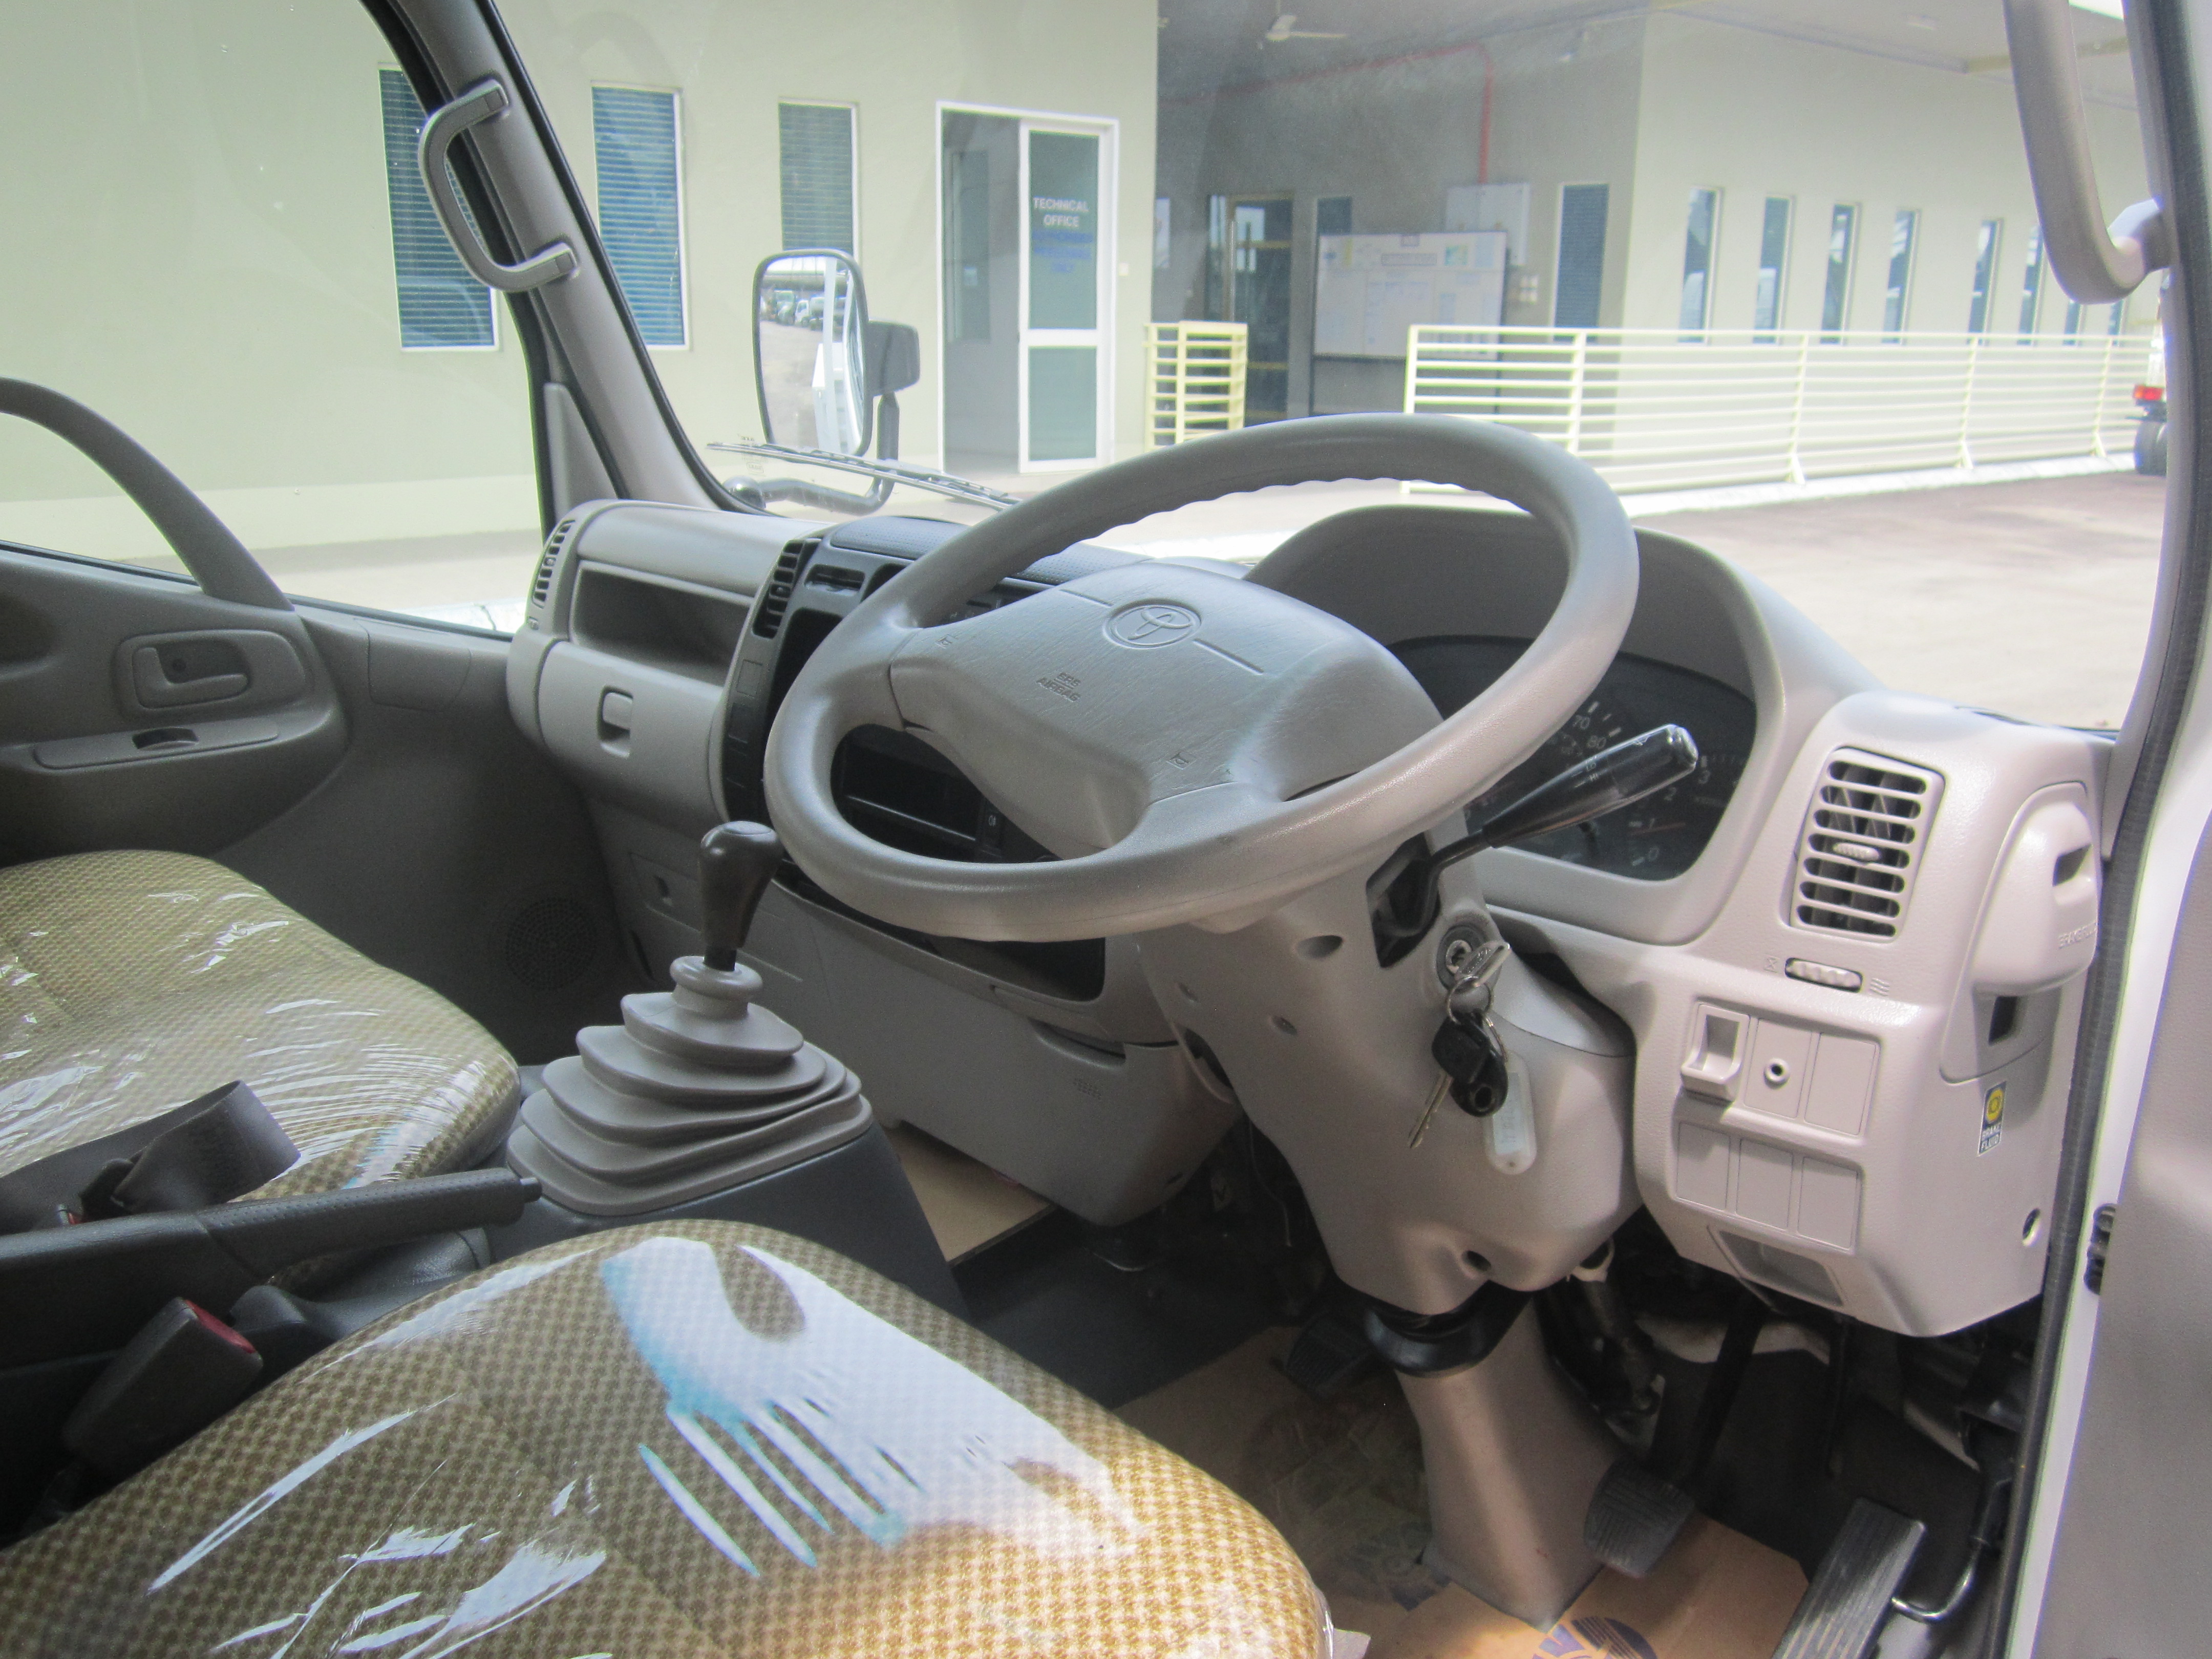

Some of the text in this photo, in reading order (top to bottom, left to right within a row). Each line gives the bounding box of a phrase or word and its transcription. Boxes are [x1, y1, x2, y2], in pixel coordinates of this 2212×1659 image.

[1033, 198, 1089, 212] TECHNICAL
[1044, 214, 1079, 227] OFFICE
[1057, 672, 1081, 687] SRS
[1036, 677, 1081, 702] AIRBAG
